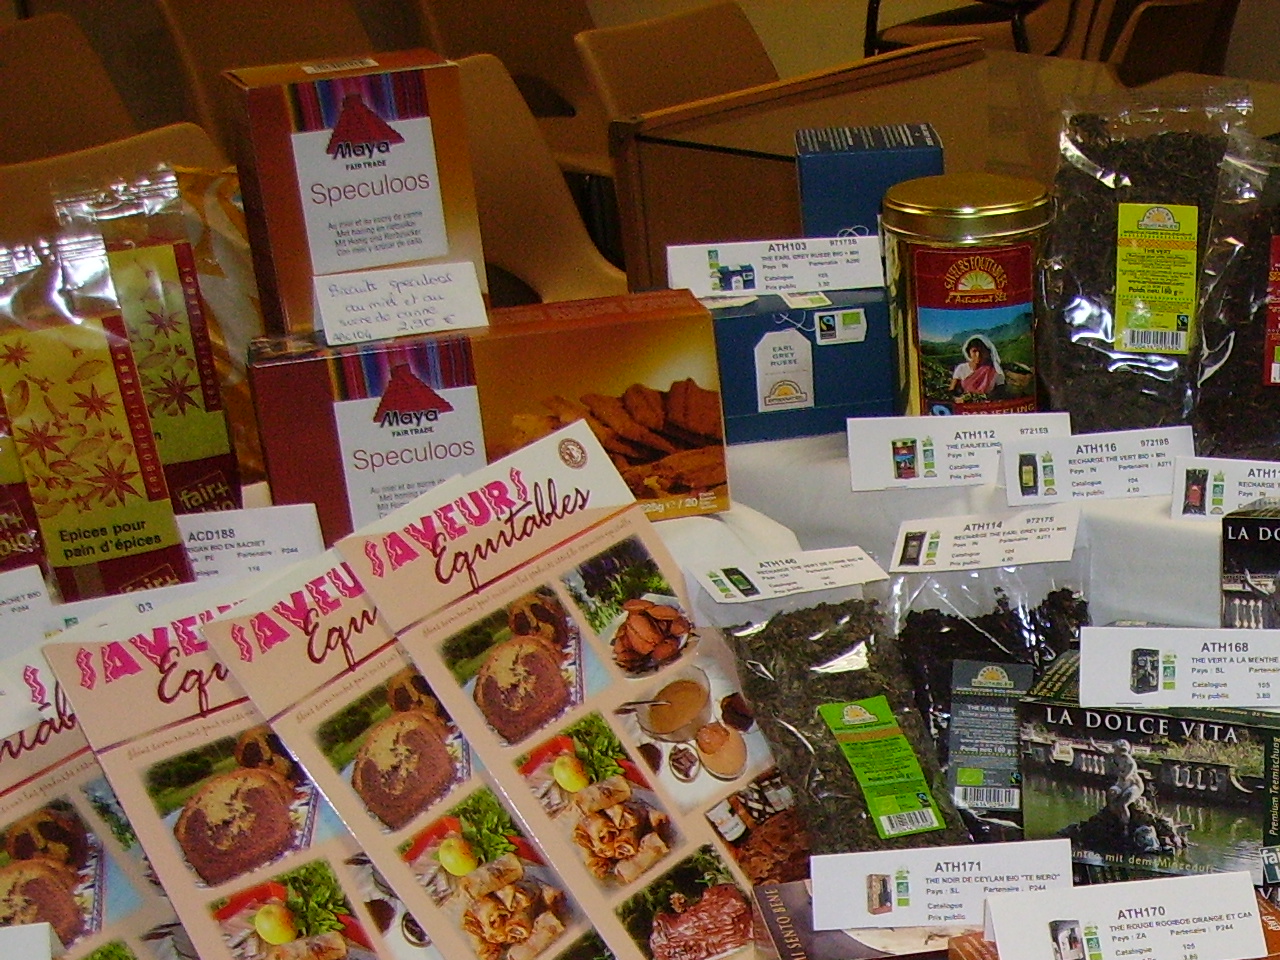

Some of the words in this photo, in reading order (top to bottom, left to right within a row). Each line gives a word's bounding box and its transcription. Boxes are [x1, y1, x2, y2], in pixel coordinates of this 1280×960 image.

[332, 141, 390, 160] Maya
[363, 161, 386, 169] TRADE
[311, 174, 430, 206] Speculoos
[768, 242, 807, 252] ATH103
[380, 409, 438, 428] Maya
[409, 427, 434, 435] TRADE
[954, 430, 996, 440] ATH112
[1076, 443, 1117, 454] ATH116
[353, 439, 475, 472] Speculoos
[365, 466, 528, 578] SAVEURS
[964, 521, 1003, 532] ATH114
[59, 526, 107, 543] Epices
[113, 520, 146, 540] pour
[188, 529, 235, 542] ACD188
[433, 478, 590, 593] Equitables
[1228, 527, 1249, 540] LA
[63, 546, 96, 560] pain
[1201, 641, 1249, 653] ATH168
[1047, 709, 1078, 726] LA
[1086, 711, 1169, 735] DOLCE
[1180, 721, 1239, 743] VITA
[934, 861, 982, 873] ATH171
[1117, 905, 1165, 920] ATH170
